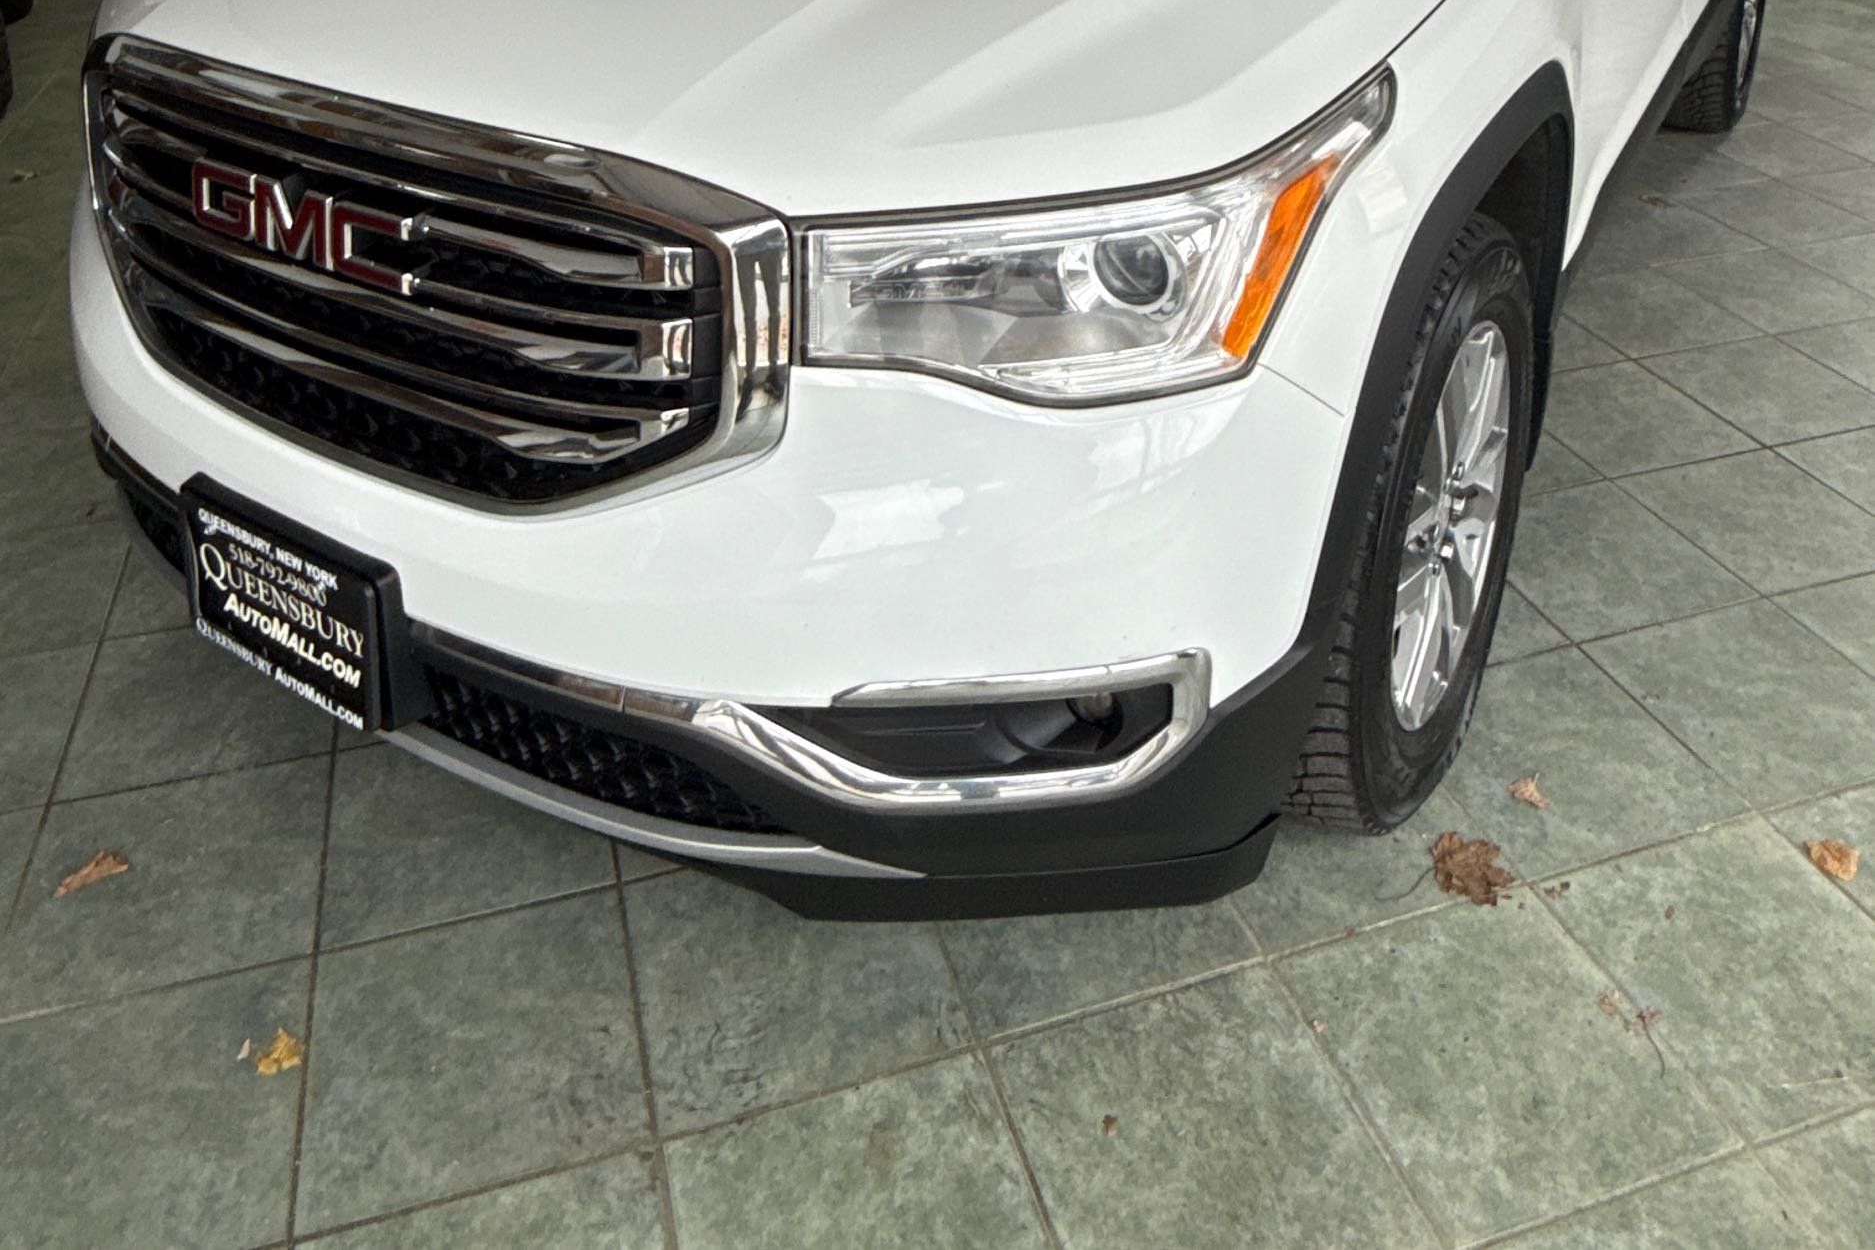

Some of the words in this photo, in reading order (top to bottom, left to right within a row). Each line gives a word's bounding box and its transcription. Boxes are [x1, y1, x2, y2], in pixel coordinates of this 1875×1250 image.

[192, 158, 412, 296] GMC
[200, 543, 364, 658] QUEENSBURY
[276, 547, 303, 572] NEW
[305, 561, 338, 591] YORK
[196, 617, 272, 676] QUEENSBURY
[224, 593, 361, 688] AUTOMALL.COM
